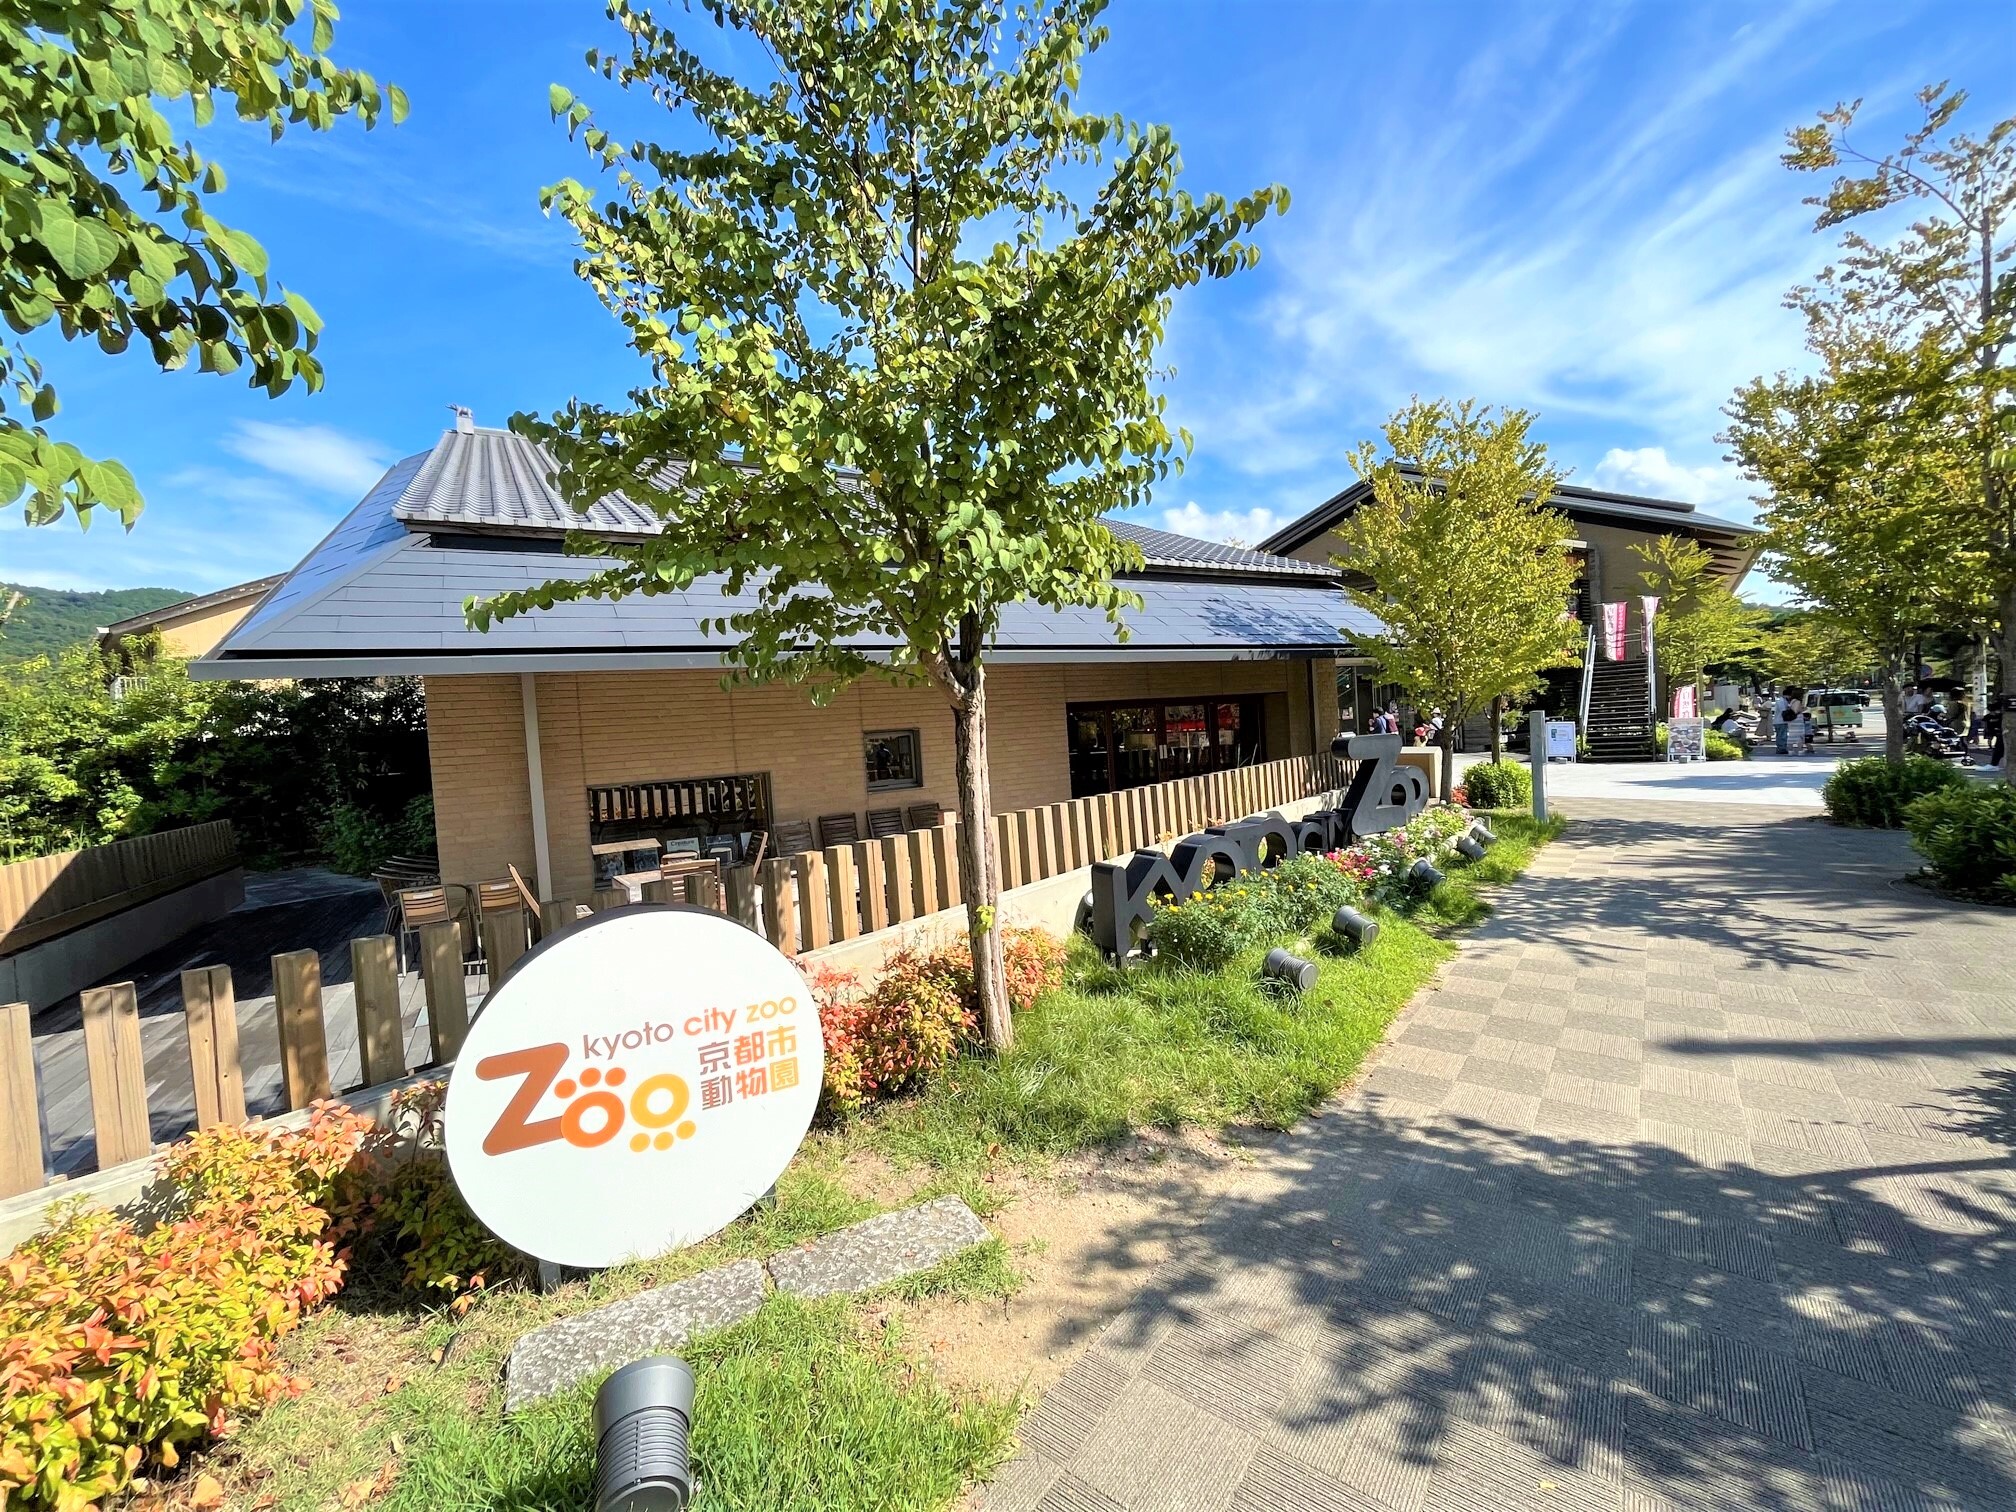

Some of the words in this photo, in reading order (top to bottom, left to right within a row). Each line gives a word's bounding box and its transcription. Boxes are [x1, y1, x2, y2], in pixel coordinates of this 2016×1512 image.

[582, 1021, 675, 1061] kyoto
[683, 1006, 737, 1035] city
[745, 996, 797, 1024] zoo
[697, 1025, 797, 1076] 京都市
[700, 1056, 800, 1111] 動物園
